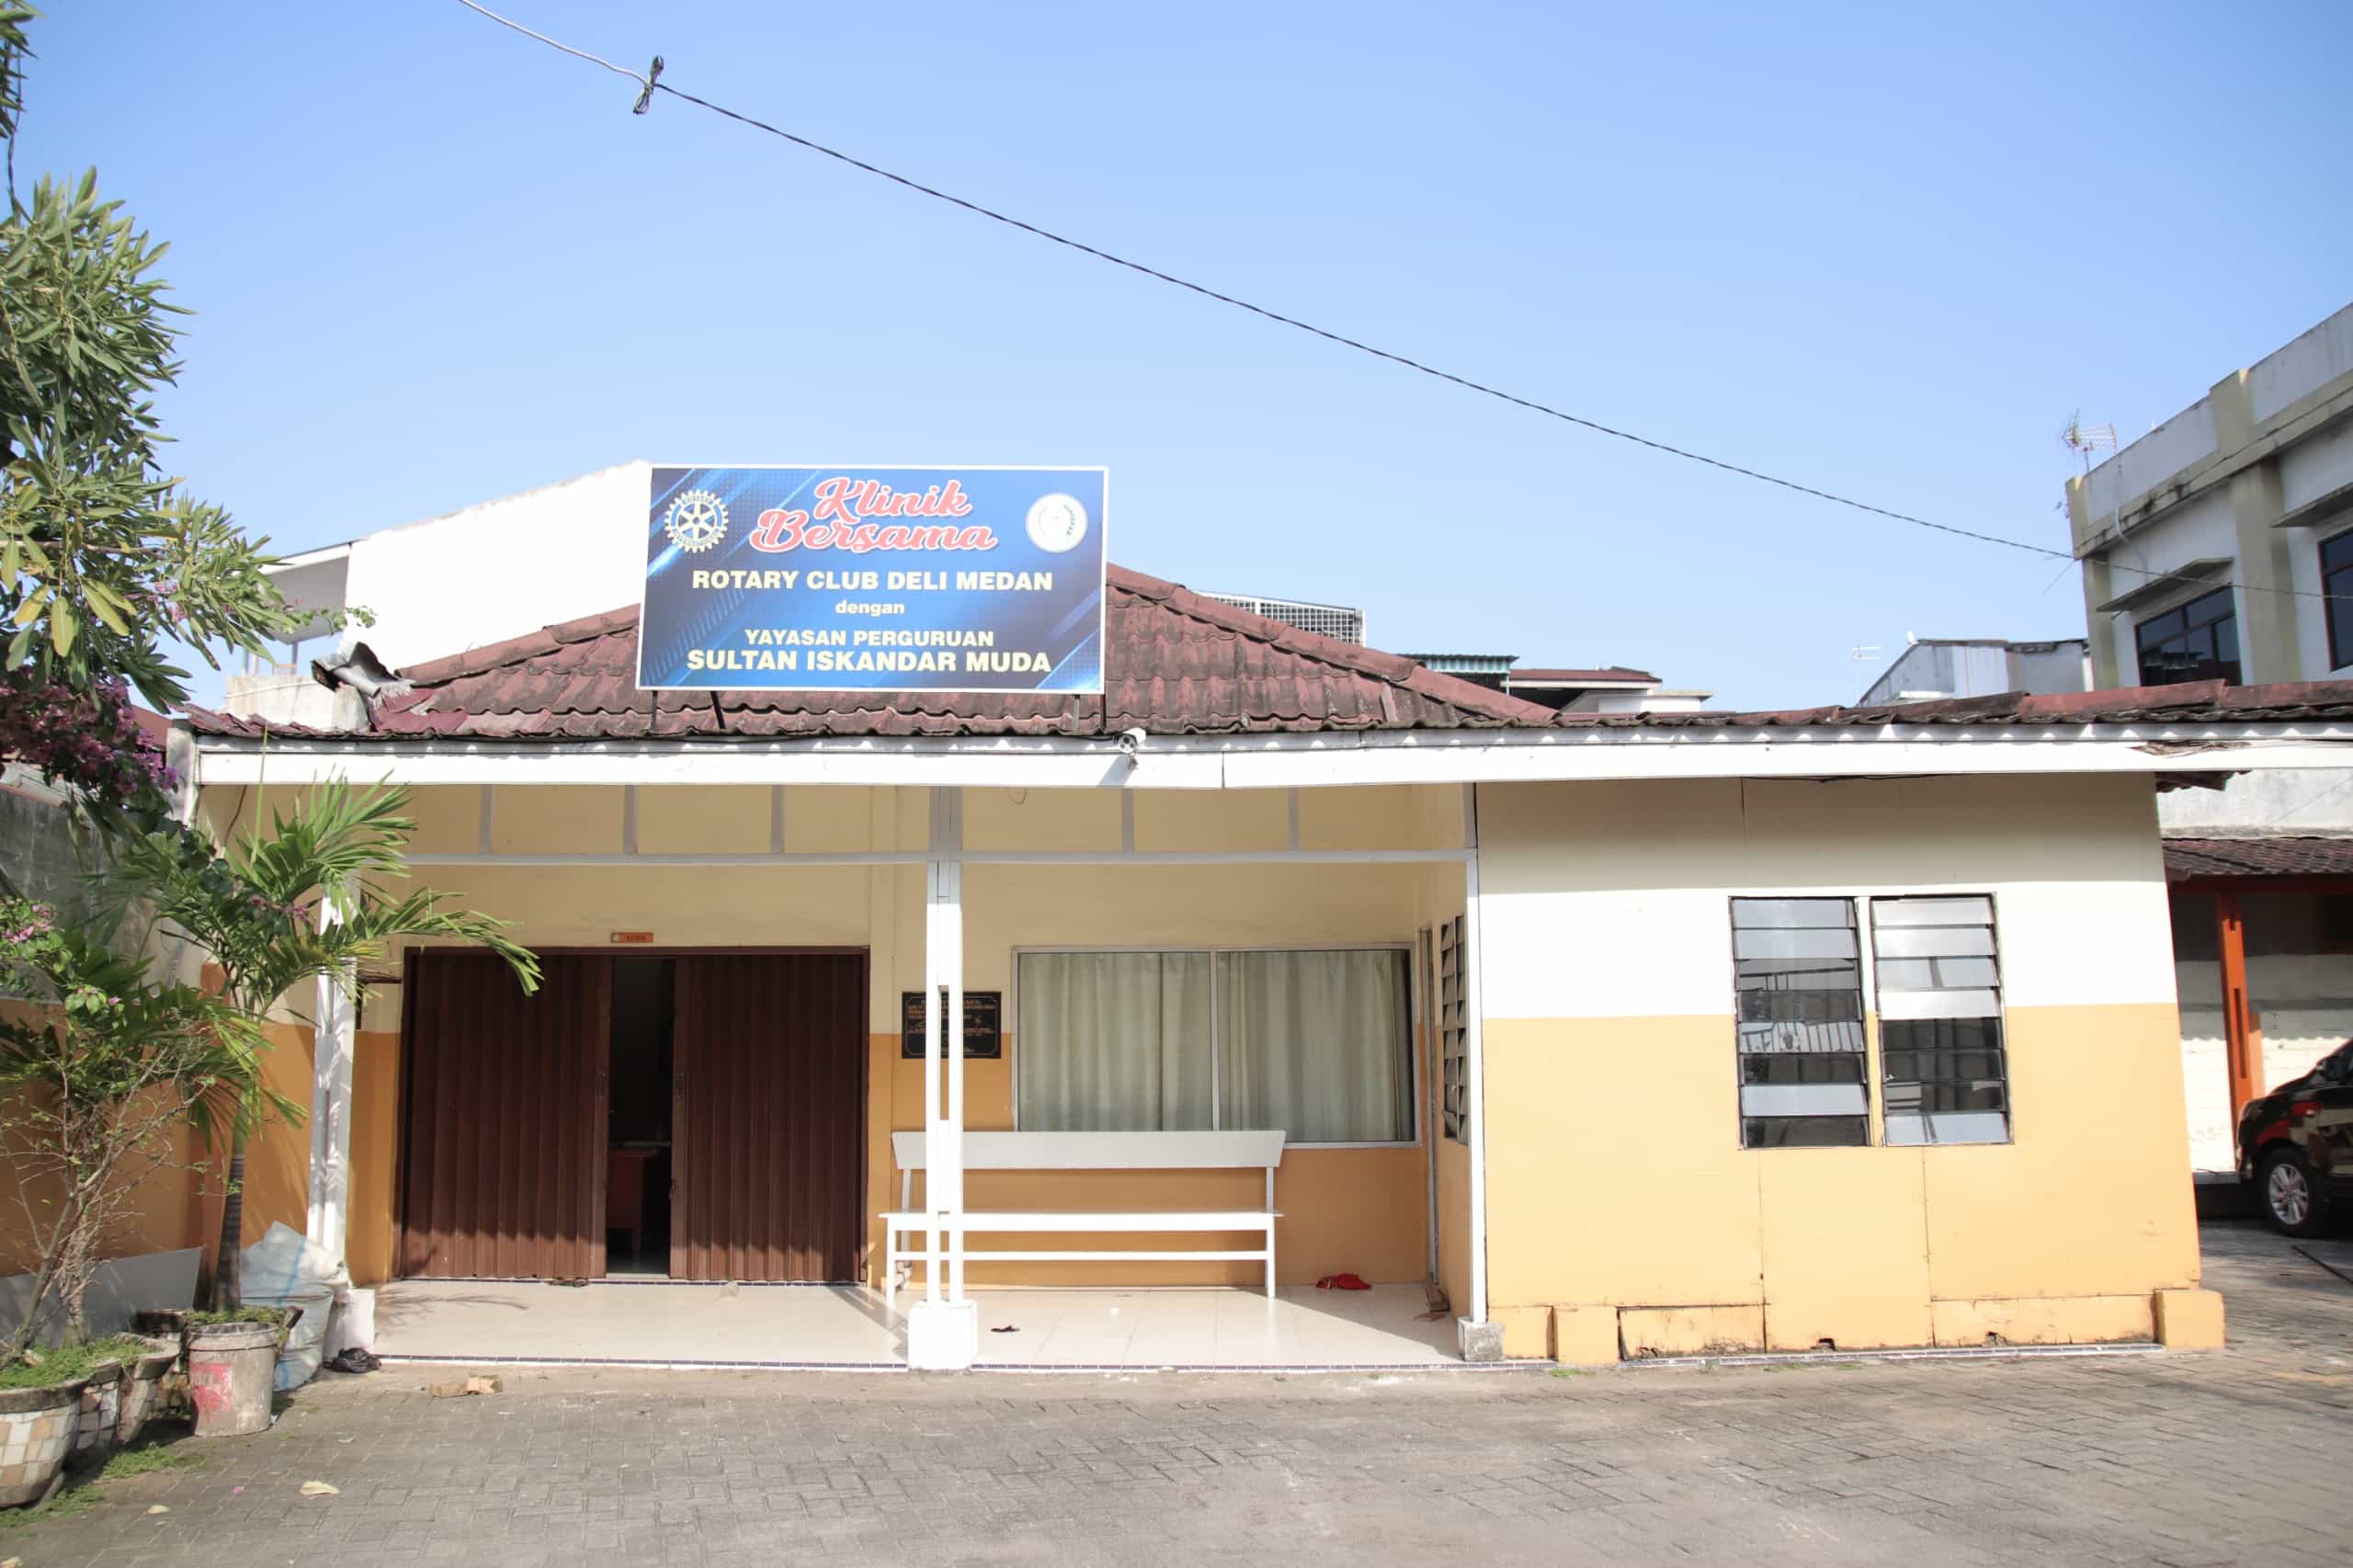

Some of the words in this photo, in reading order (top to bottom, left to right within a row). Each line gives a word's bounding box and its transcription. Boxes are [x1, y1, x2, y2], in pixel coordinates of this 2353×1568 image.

[814, 477, 972, 524] Klinik
[750, 509, 997, 552] Bersama
[692, 570, 799, 589] ROTARY
[807, 570, 879, 590] CLUB
[887, 572, 948, 591] DELI
[956, 572, 1053, 591] MEDAN
[835, 600, 905, 617] dengan
[745, 629, 847, 646] YAYASAN
[853, 631, 994, 647] PERGURUAN
[687, 649, 797, 670] SULTAN
[807, 651, 957, 672] ISKANDAR
[965, 652, 1051, 673] MUDA
